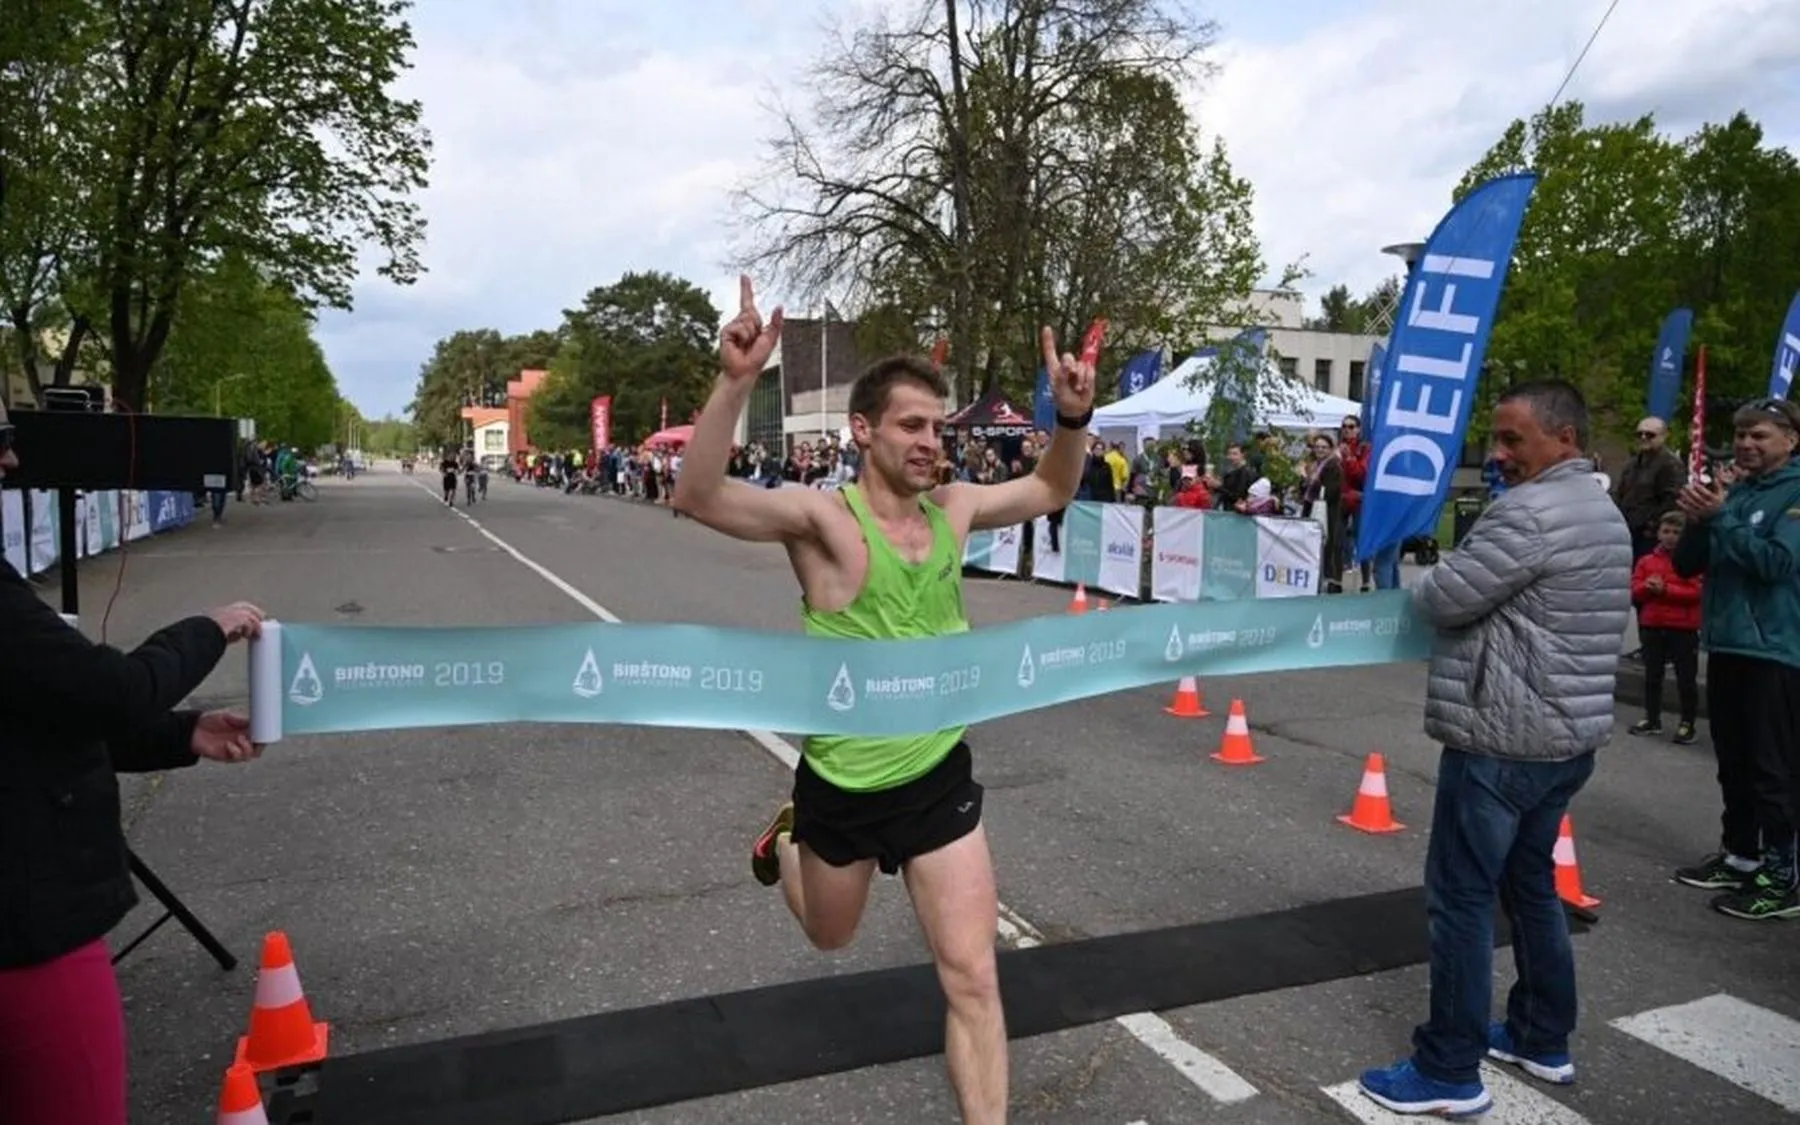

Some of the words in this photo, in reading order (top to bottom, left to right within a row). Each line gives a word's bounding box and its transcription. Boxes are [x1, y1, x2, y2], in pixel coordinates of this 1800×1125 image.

[1374, 254, 1496, 497] DELFI
[1264, 564, 1310, 589] DELFI
[1238, 626, 1277, 647] 2019
[1088, 639, 1127, 664] 2019
[335, 662, 425, 681] BIRŠTONO
[434, 661, 505, 686] 2019
[612, 661, 693, 680] BIRŠTONO
[700, 667, 765, 693] 2019
[865, 674, 936, 693] BIRŠTONO
[938, 665, 982, 696] 2019
